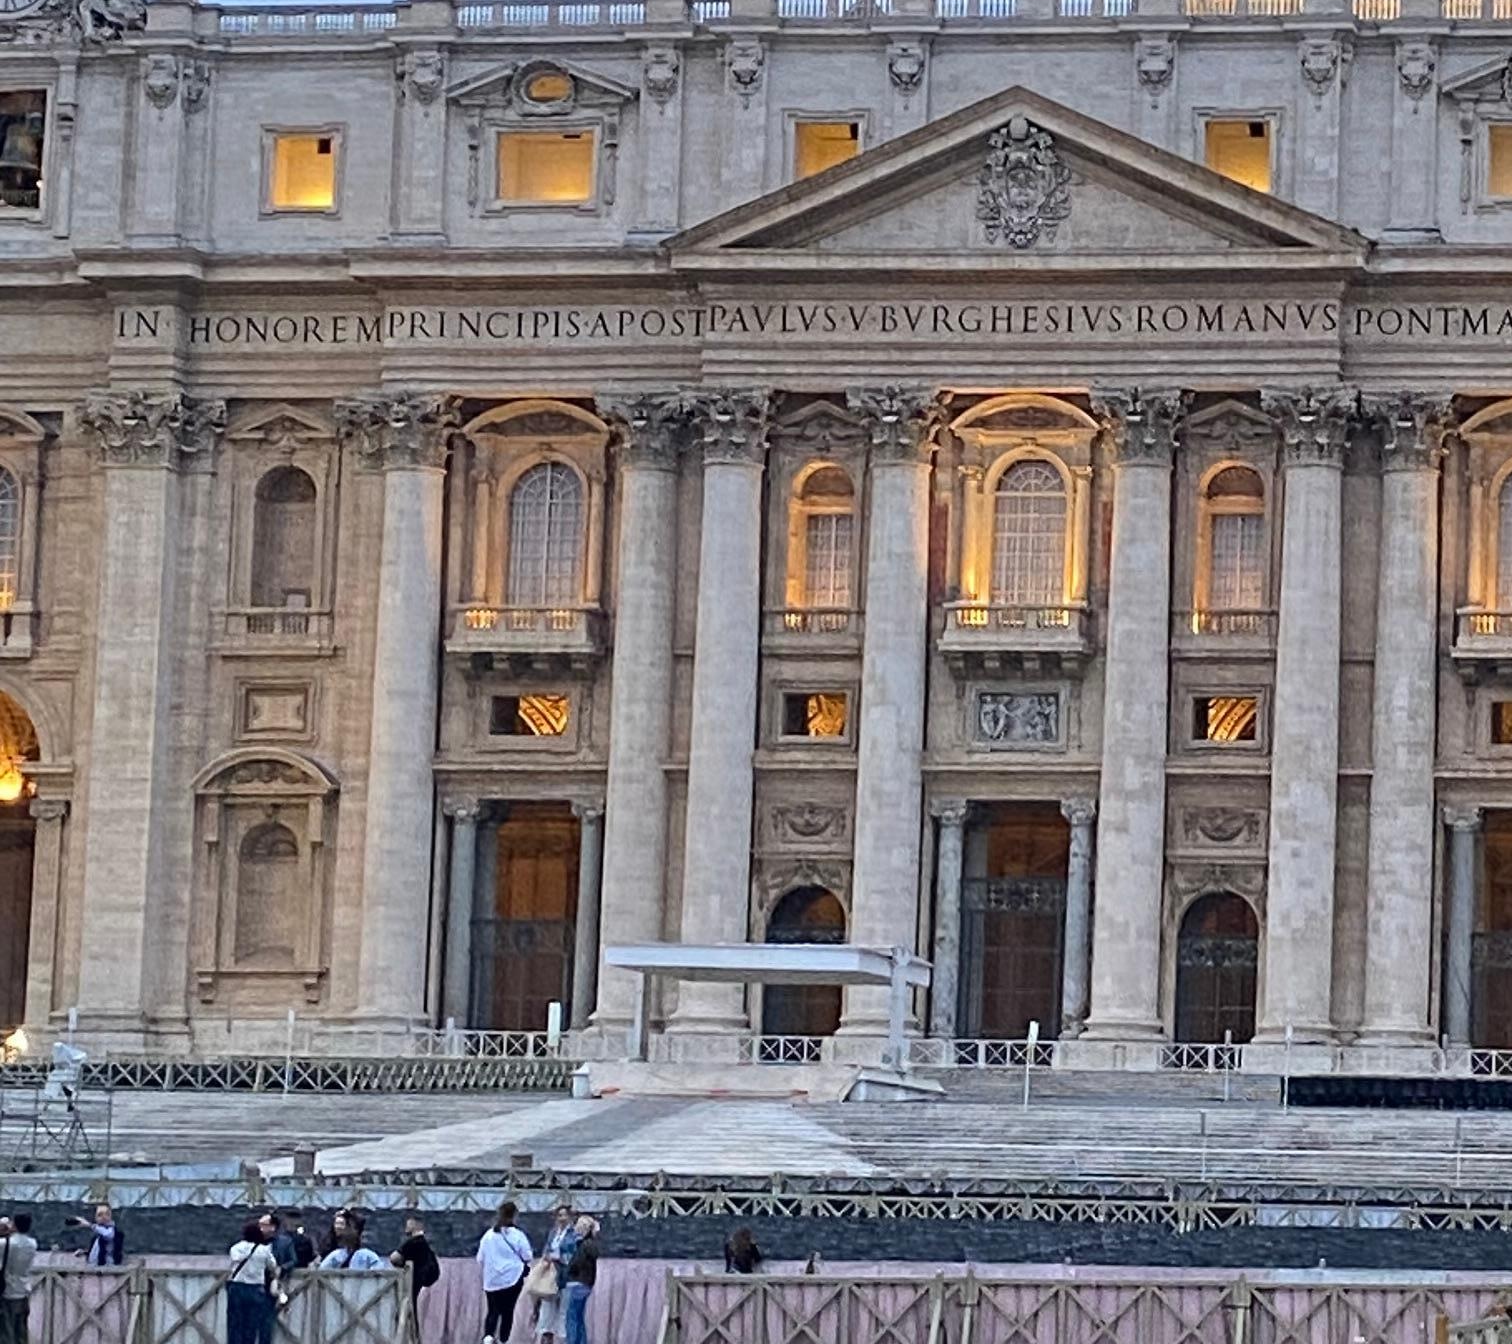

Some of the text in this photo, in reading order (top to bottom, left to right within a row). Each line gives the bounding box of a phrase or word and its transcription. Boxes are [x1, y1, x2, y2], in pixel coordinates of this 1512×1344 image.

[117, 310, 160, 338] IN
[189, 315, 383, 344] HONOREM
[388, 309, 582, 339] PRINCIPIS
[588, 308, 706, 338] APOST
[708, 304, 838, 333] PAVLVS
[848, 304, 868, 333] V
[880, 304, 1122, 334] BVRGHESIVS
[1136, 303, 1338, 333] ROMANVS
[1354, 306, 1457, 336] PONT
